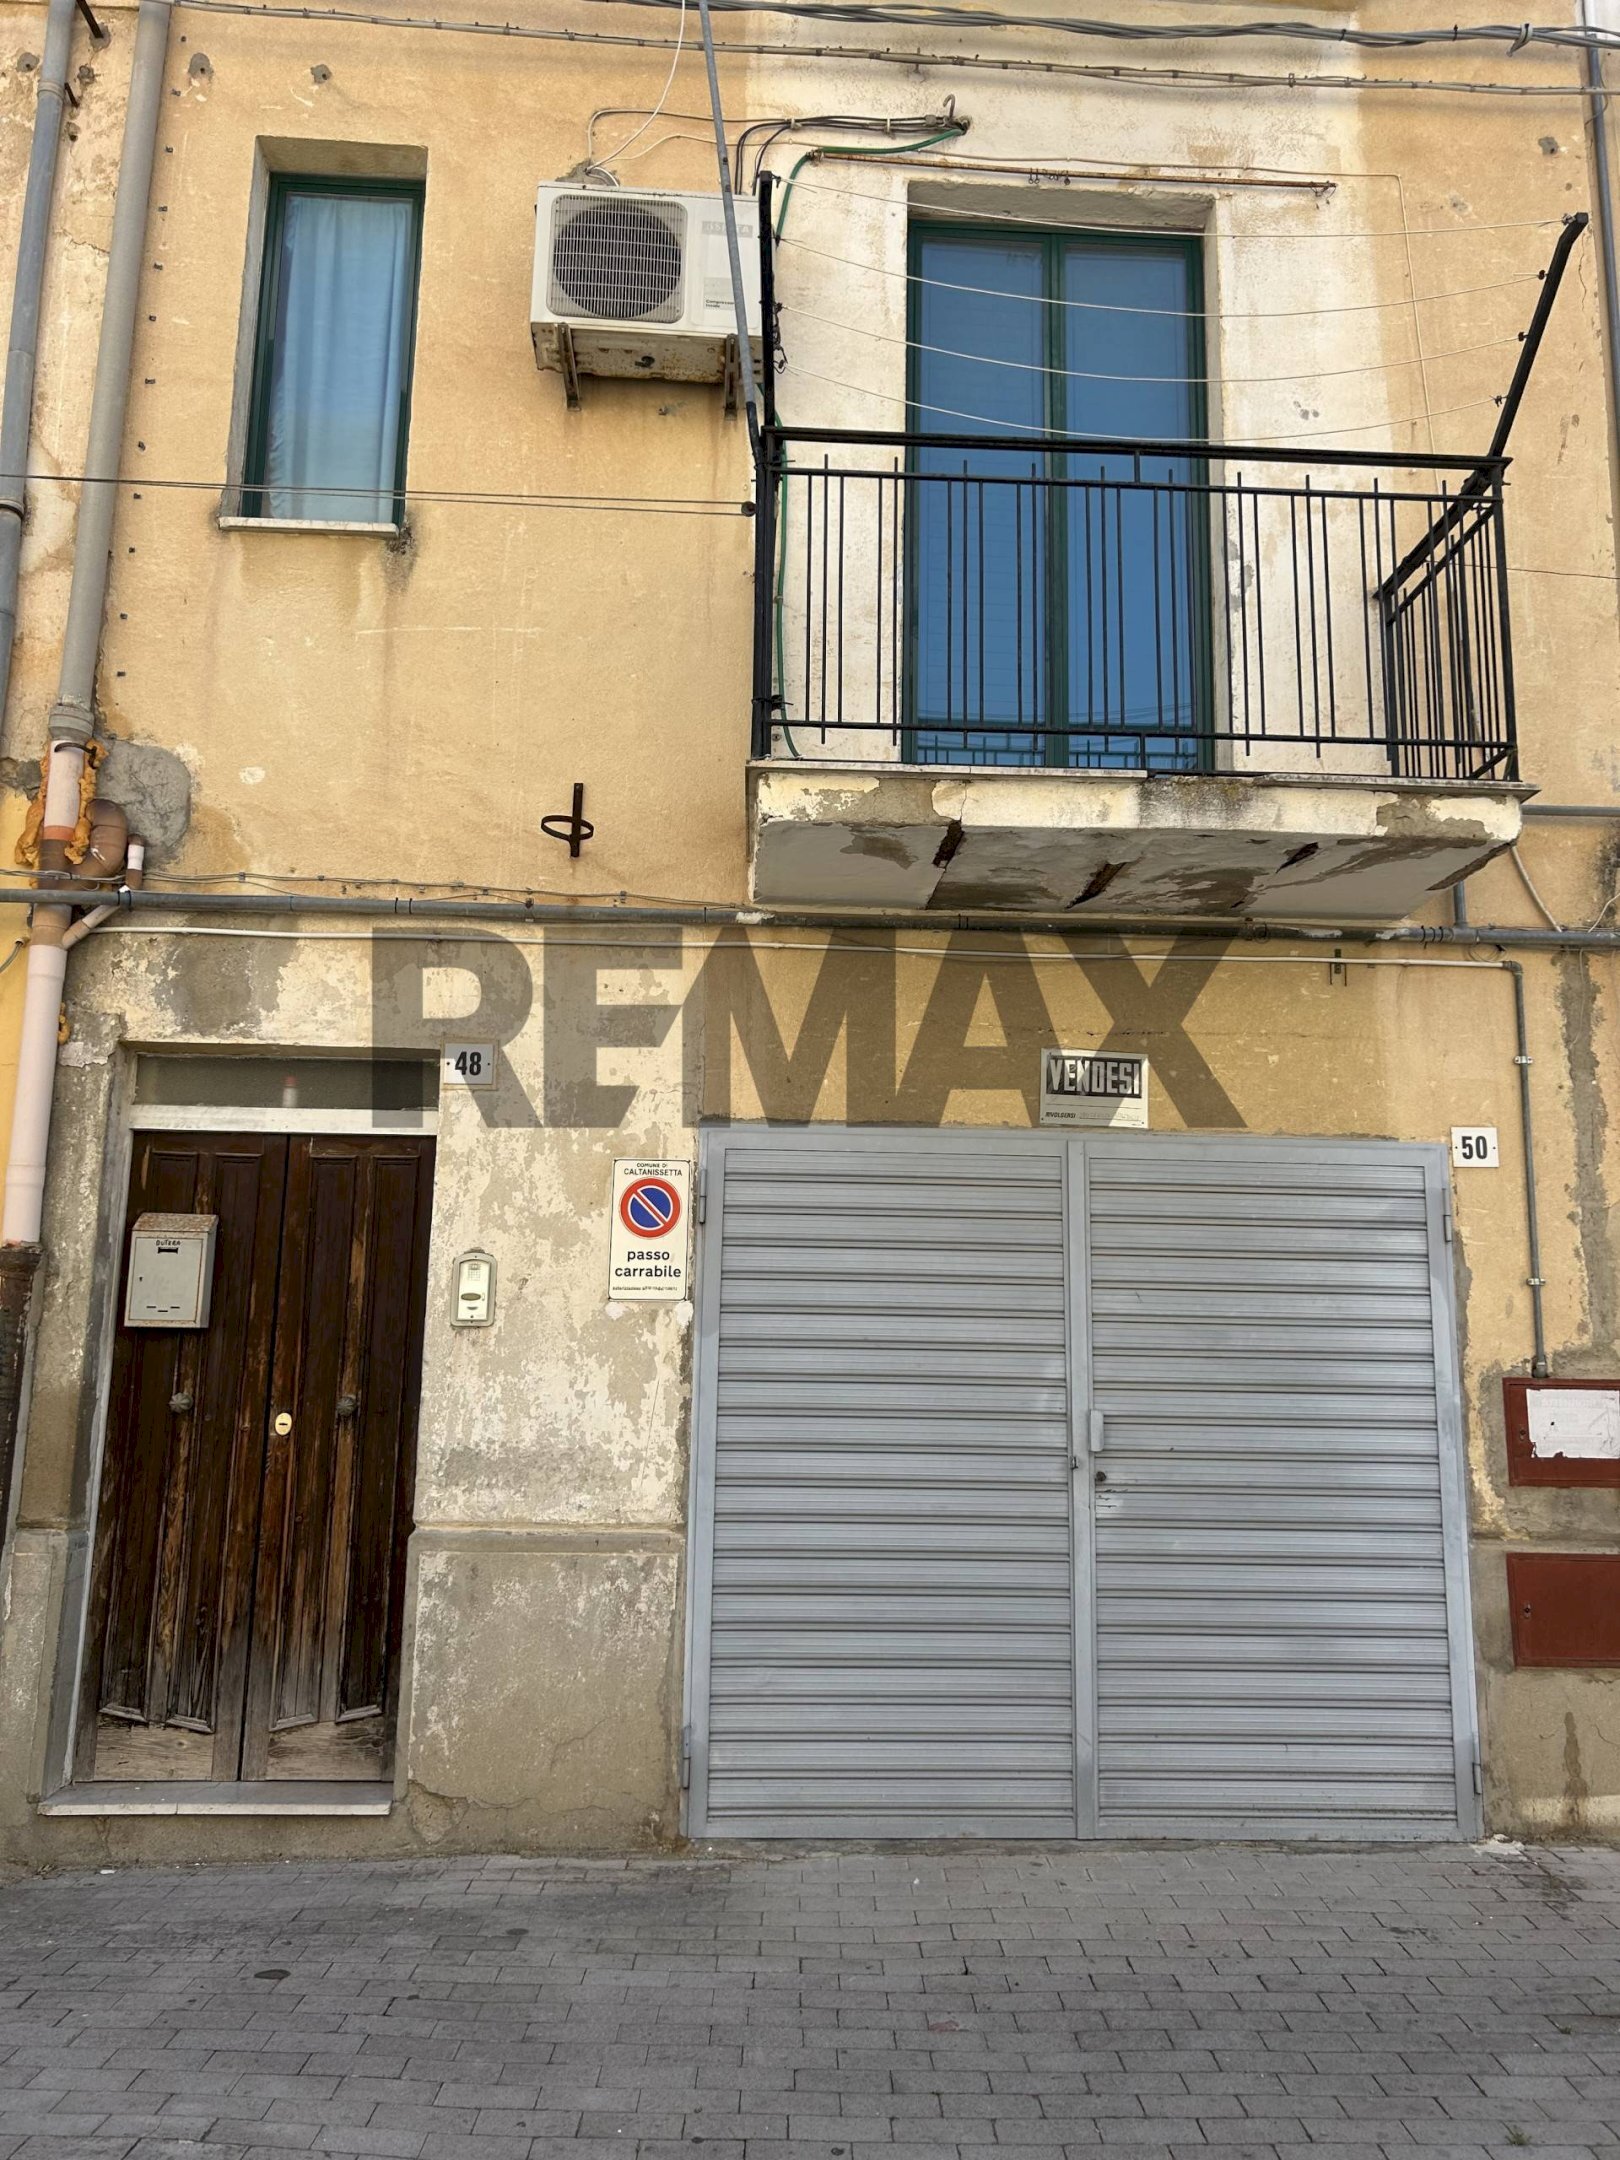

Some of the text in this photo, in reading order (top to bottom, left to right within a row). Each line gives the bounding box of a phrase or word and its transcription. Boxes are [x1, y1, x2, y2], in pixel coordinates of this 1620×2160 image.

[454, 1051, 482, 1076] 48
[1049, 1059, 1140, 1095] VENDESI
[1461, 1135, 1488, 1160] 50
[623, 1168, 683, 1176] CALTANISSETTA
[627, 1250, 670, 1262] passo
[614, 1265, 682, 1278] carrabile
